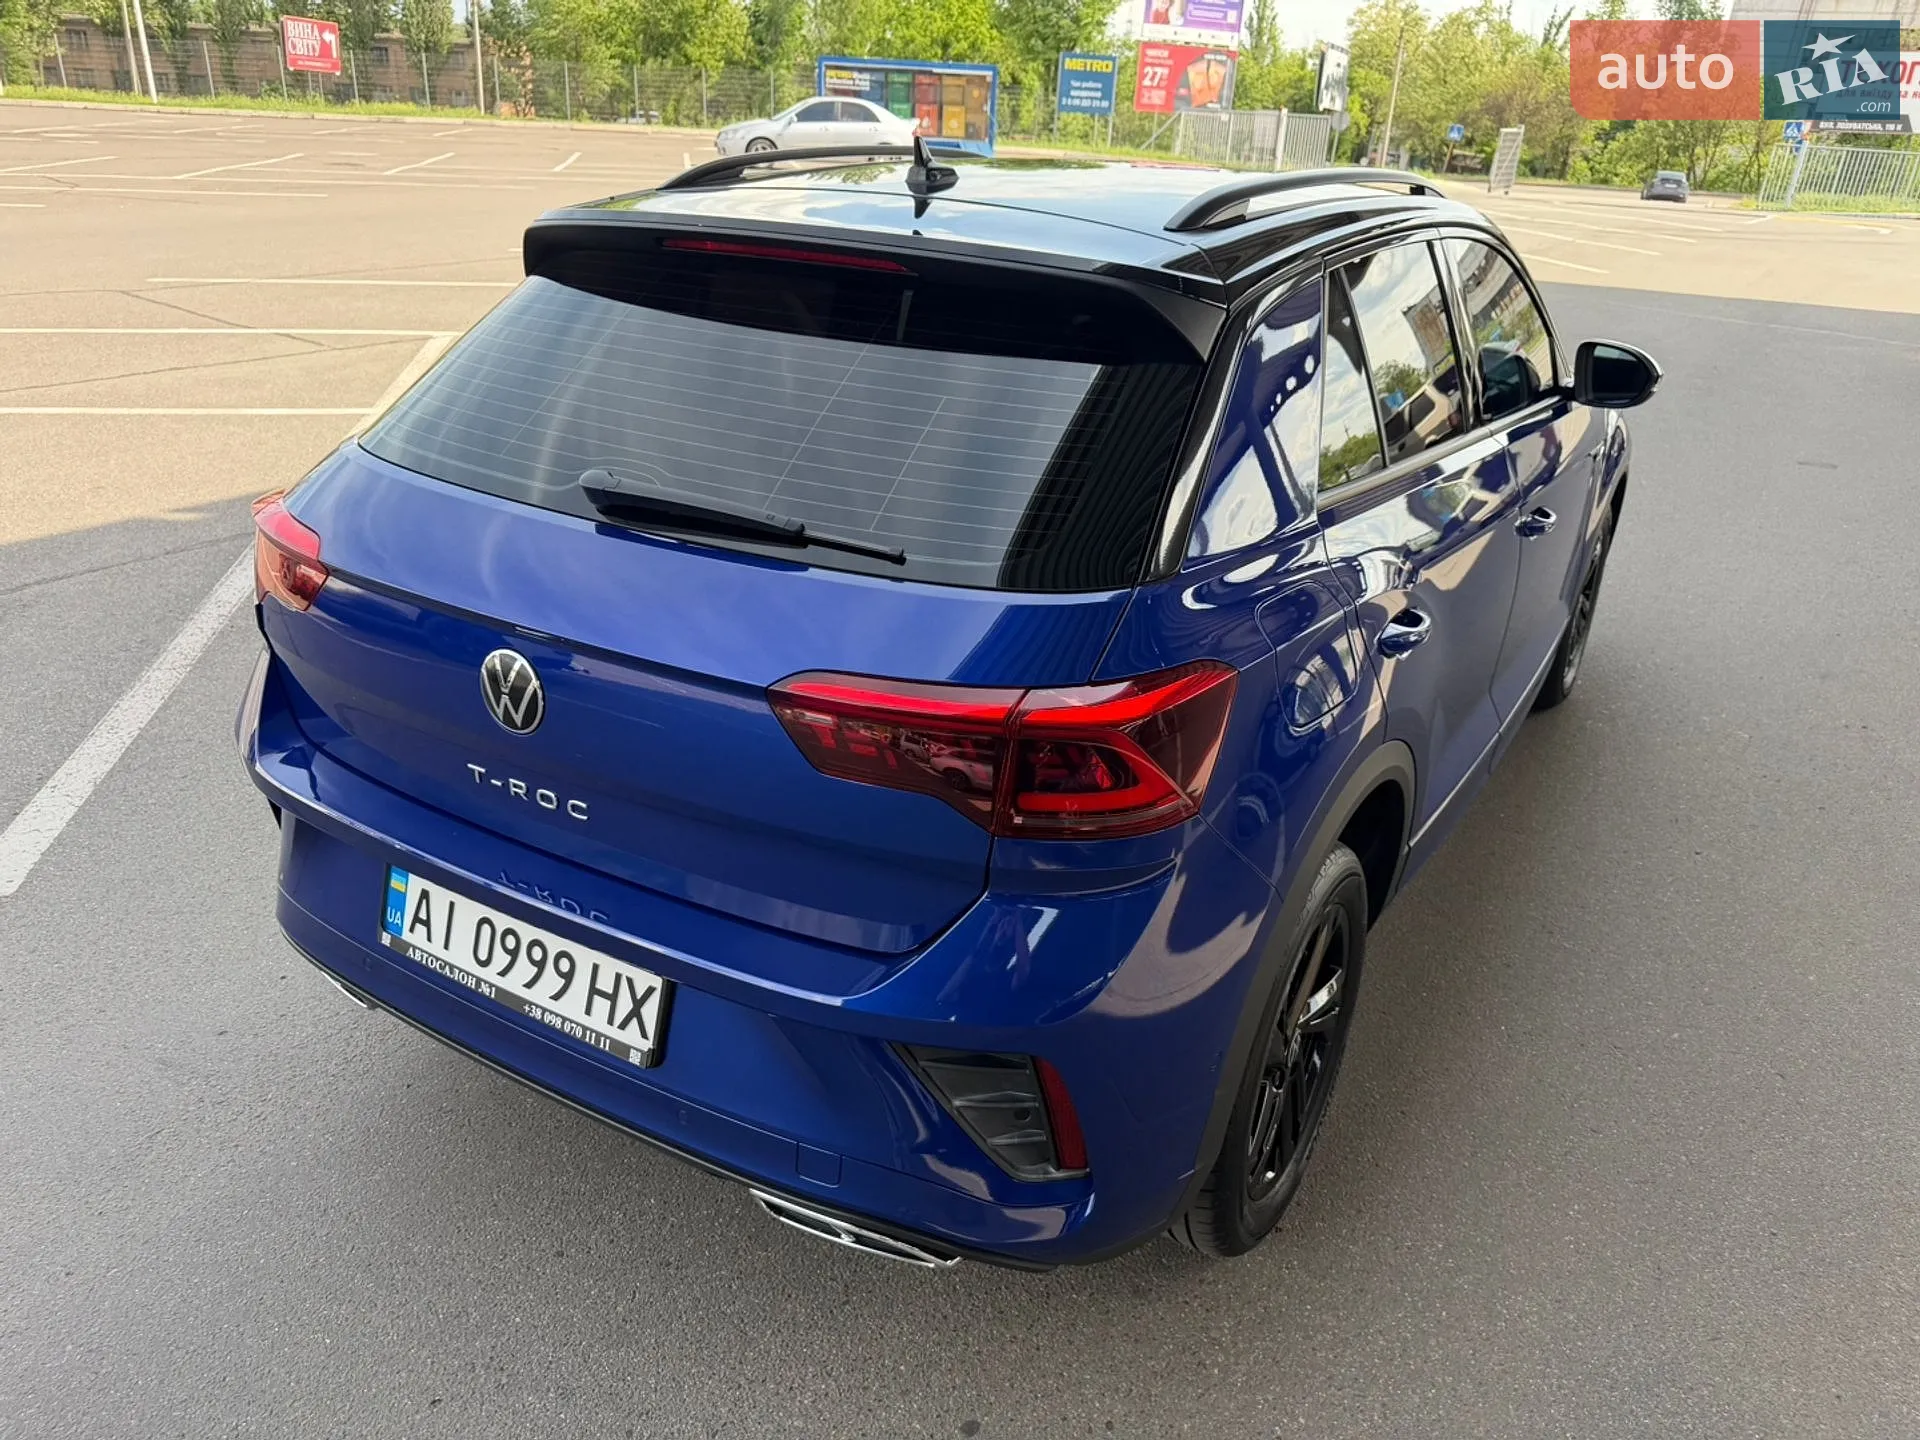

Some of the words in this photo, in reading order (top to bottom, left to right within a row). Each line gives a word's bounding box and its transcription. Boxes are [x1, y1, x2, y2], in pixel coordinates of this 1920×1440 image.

[287, 21, 321, 39] ВИНА
[288, 38, 321, 56] СВІТУ
[1064, 58, 1114, 73] METRO
[467, 763, 588, 821] T-ROC
[386, 906, 403, 928] UA
[409, 888, 455, 950] AI
[472, 916, 576, 1001] 0999
[584, 962, 657, 1040] HX
[406, 946, 476, 990] АВТОСАЛОН
[478, 981, 496, 999] №1
[523, 1003, 541, 1021] +38
[544, 1011, 562, 1030] 098
[564, 1020, 582, 1039] 070
[585, 1027, 595, 1046] 11
[600, 1034, 610, 1051] 11
